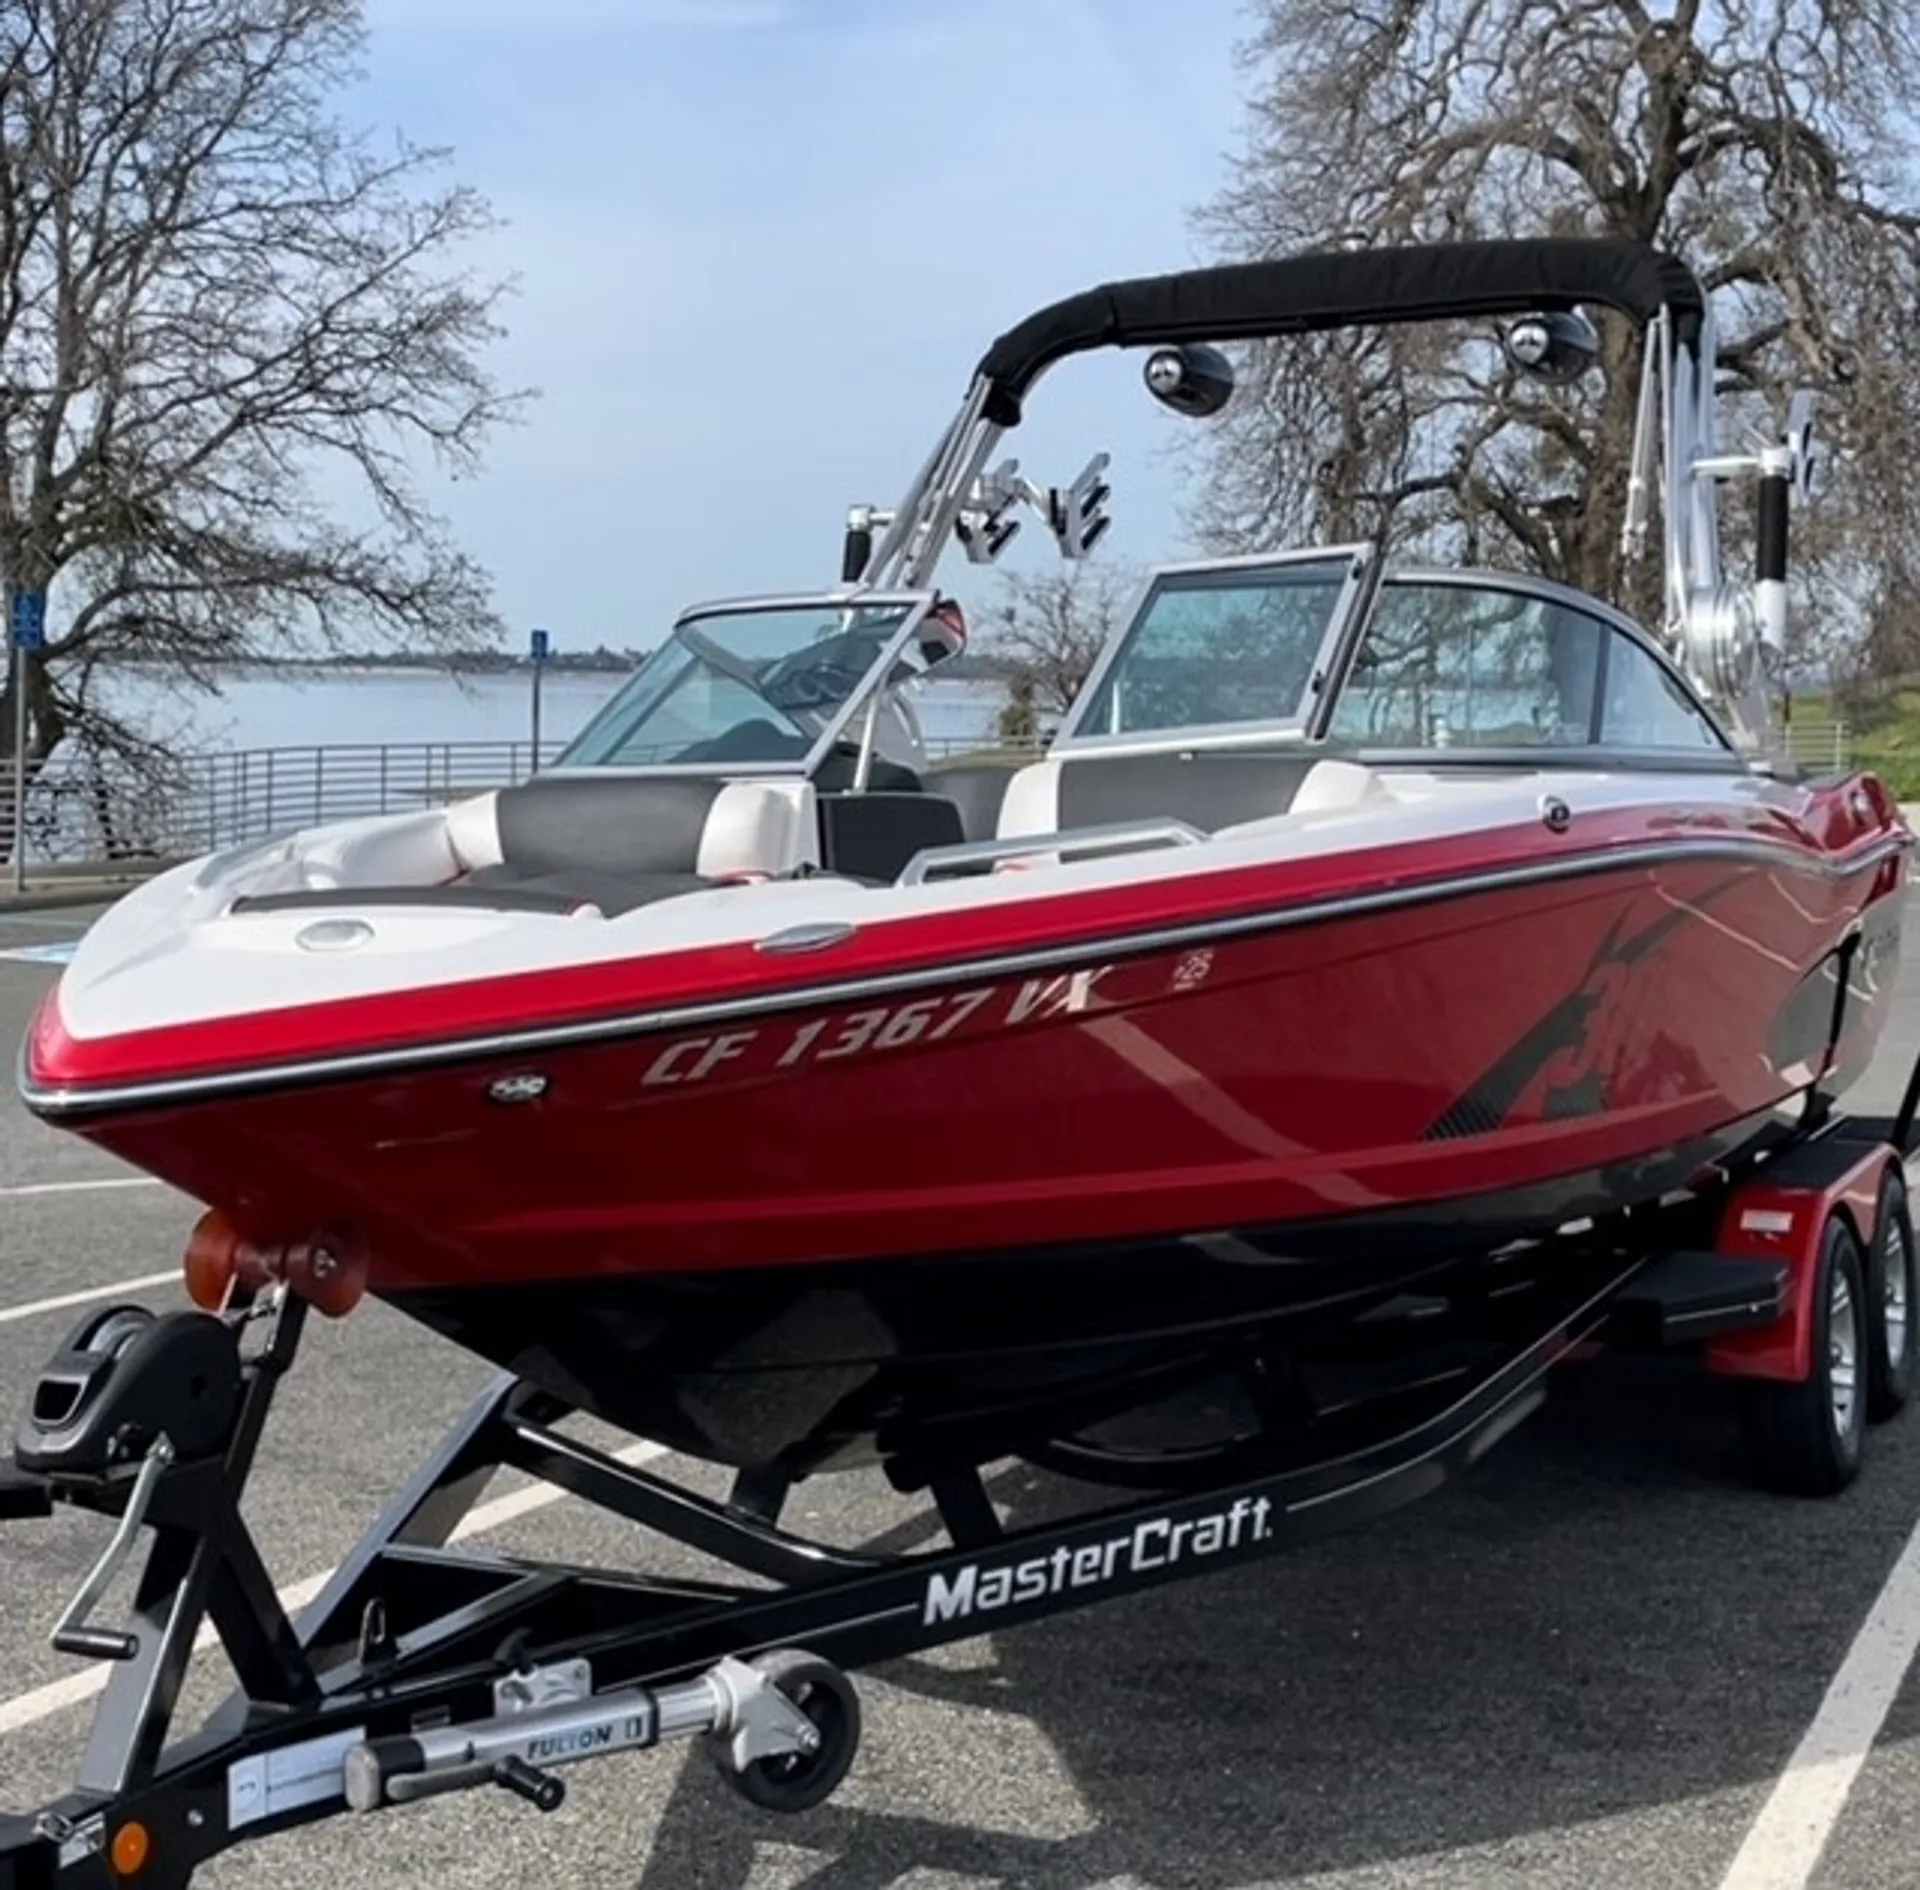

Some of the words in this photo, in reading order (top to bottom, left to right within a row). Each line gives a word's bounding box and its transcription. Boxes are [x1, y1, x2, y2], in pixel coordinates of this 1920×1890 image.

[641, 1030, 758, 1086] CF
[776, 987, 995, 1067] 1367
[1004, 965, 1113, 1025] VX
[922, 1496, 1273, 1626] MasterCraft
[527, 1724, 613, 1760] FULTON
